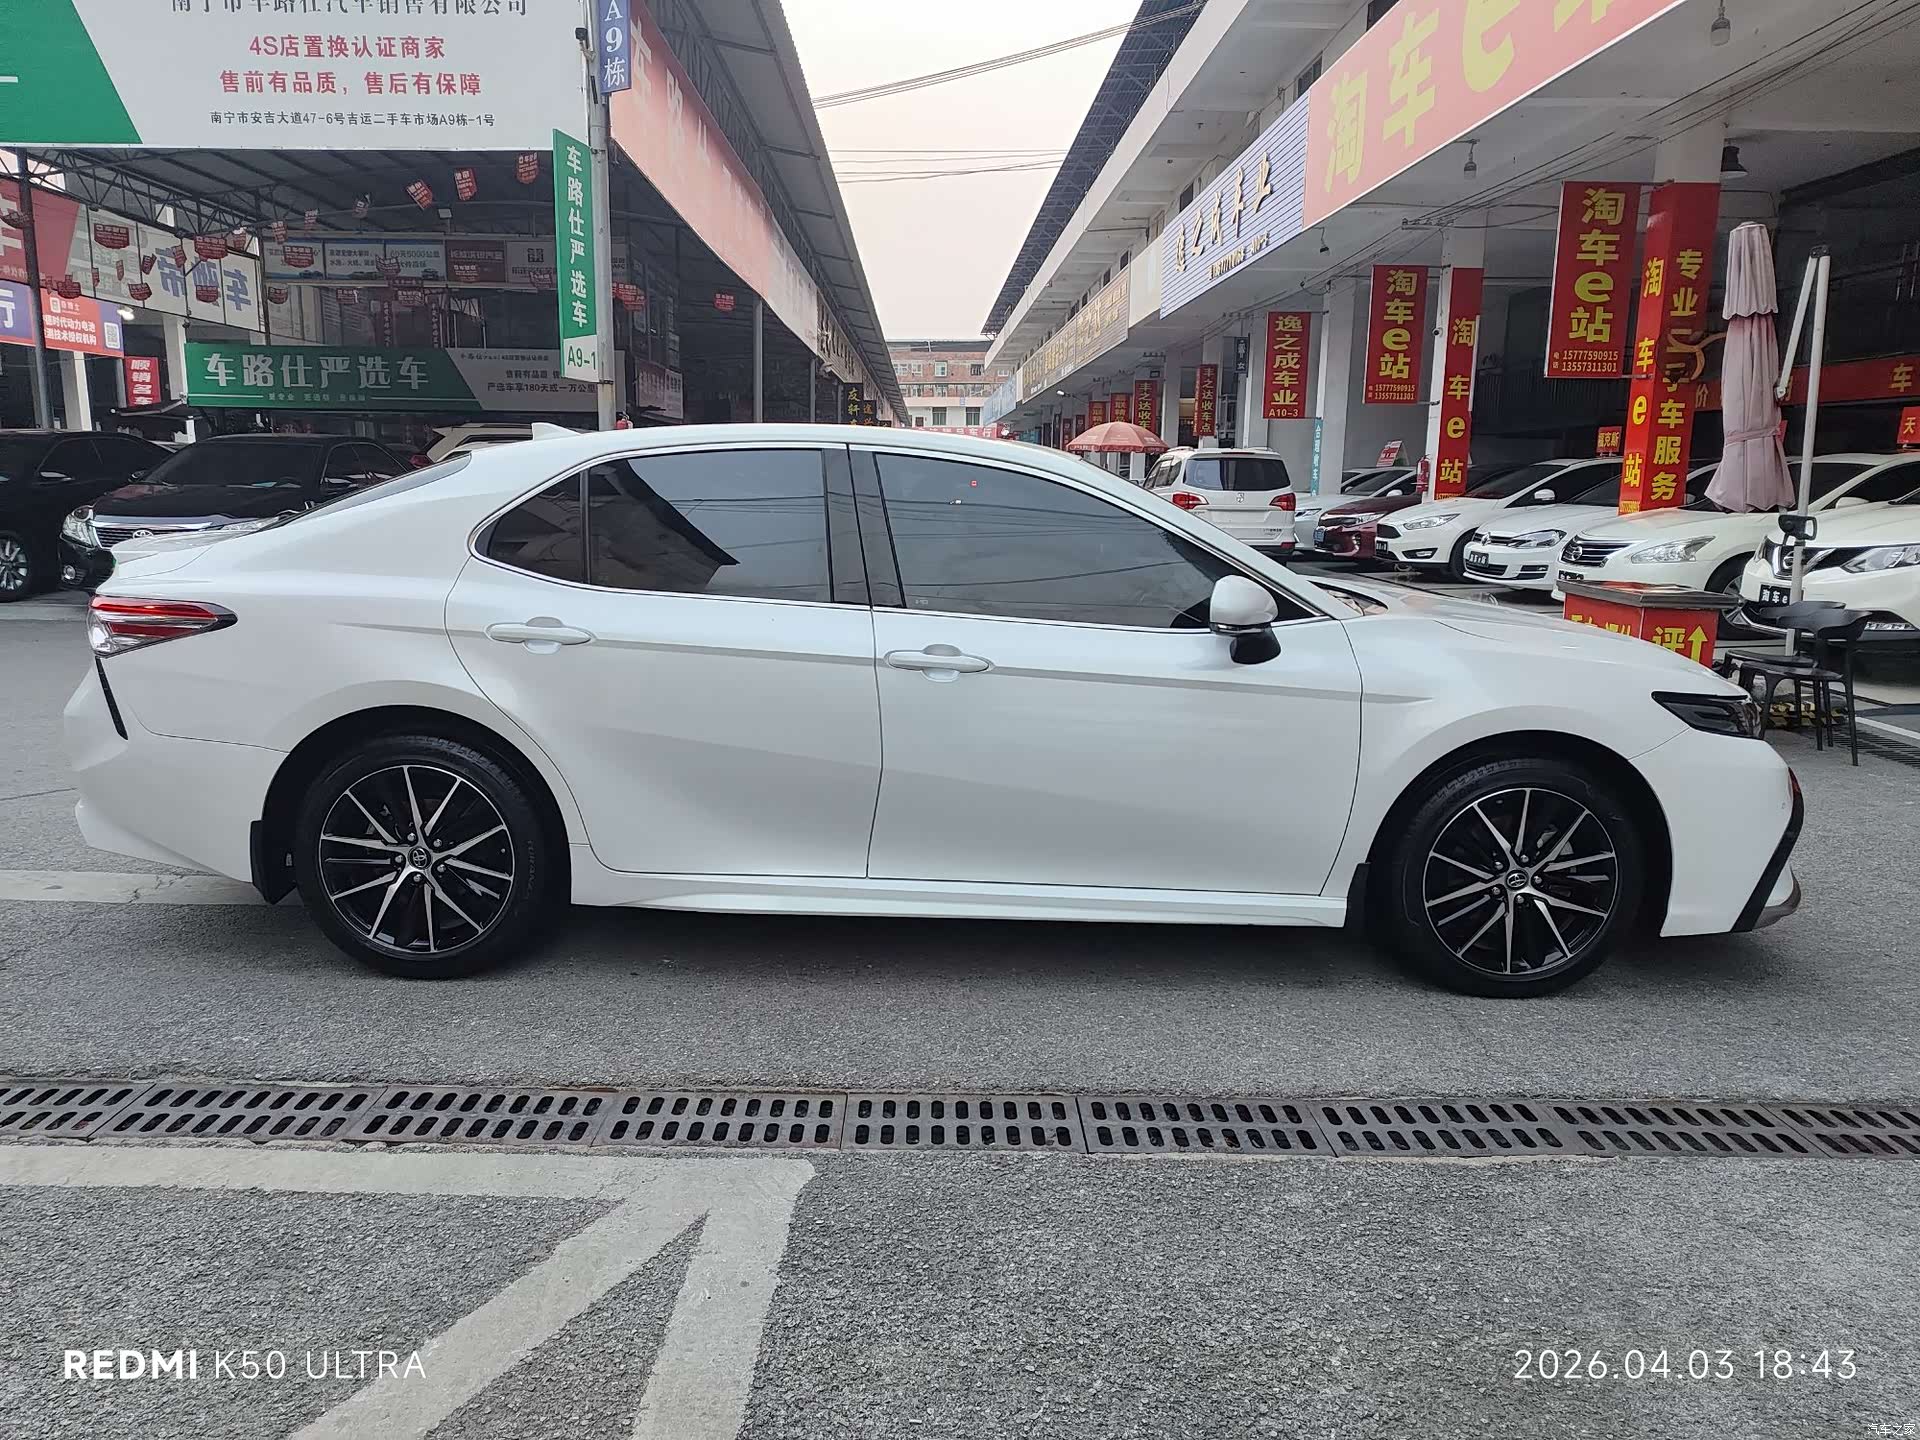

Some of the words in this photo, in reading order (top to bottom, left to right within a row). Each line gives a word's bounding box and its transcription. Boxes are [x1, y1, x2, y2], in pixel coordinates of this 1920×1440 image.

[250, 34, 446, 59] 4S店置换认证商家
[603, 0, 626, 88] A9栋
[219, 70, 482, 96] 售前有品质，售后有保障
[1325, 0, 1609, 193] 淘车e
[209, 110, 496, 128] 南宁市安吉大道47-6号吉运二手车市场A9栋-1号
[565, 145, 588, 328] 车路仕严选车
[1568, 187, 1626, 343] 淘车e站
[1378, 269, 1418, 380] 淘车e站
[203, 352, 430, 391] 车路仕严选车
[566, 345, 598, 371] A9-1
[1270, 315, 1303, 406] 逸之成车业
[1561, 361, 1618, 373] 13557311301
[1562, 350, 1619, 361] 15777590915
[1624, 257, 1665, 488] 淘车e站
[1888, 362, 1914, 393] 车
[1268, 408, 1299, 418] A10-3
[1440, 318, 1478, 484] 淘车e站
